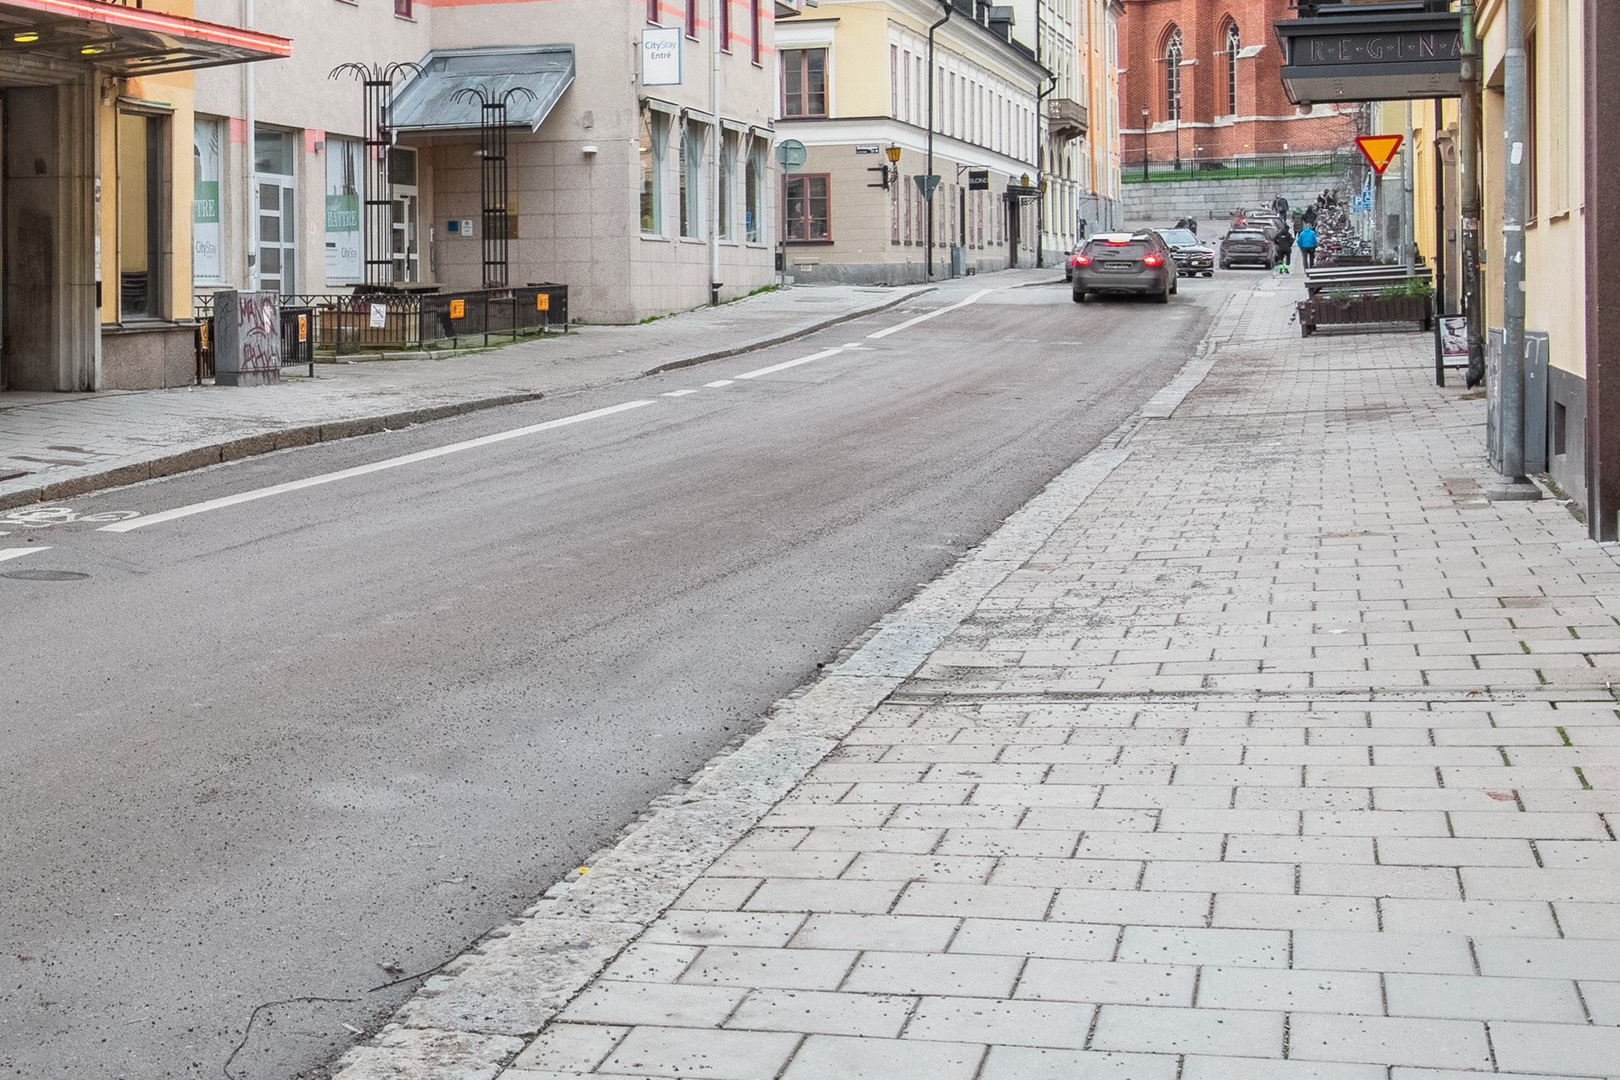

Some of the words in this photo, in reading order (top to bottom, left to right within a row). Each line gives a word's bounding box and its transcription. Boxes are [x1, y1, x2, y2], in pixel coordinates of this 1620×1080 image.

[644, 40, 677, 51] CityStay
[1310, 34, 1460, 61] REGINA
[651, 51, 672, 60] Entré
[194, 199, 215, 218] TRE
